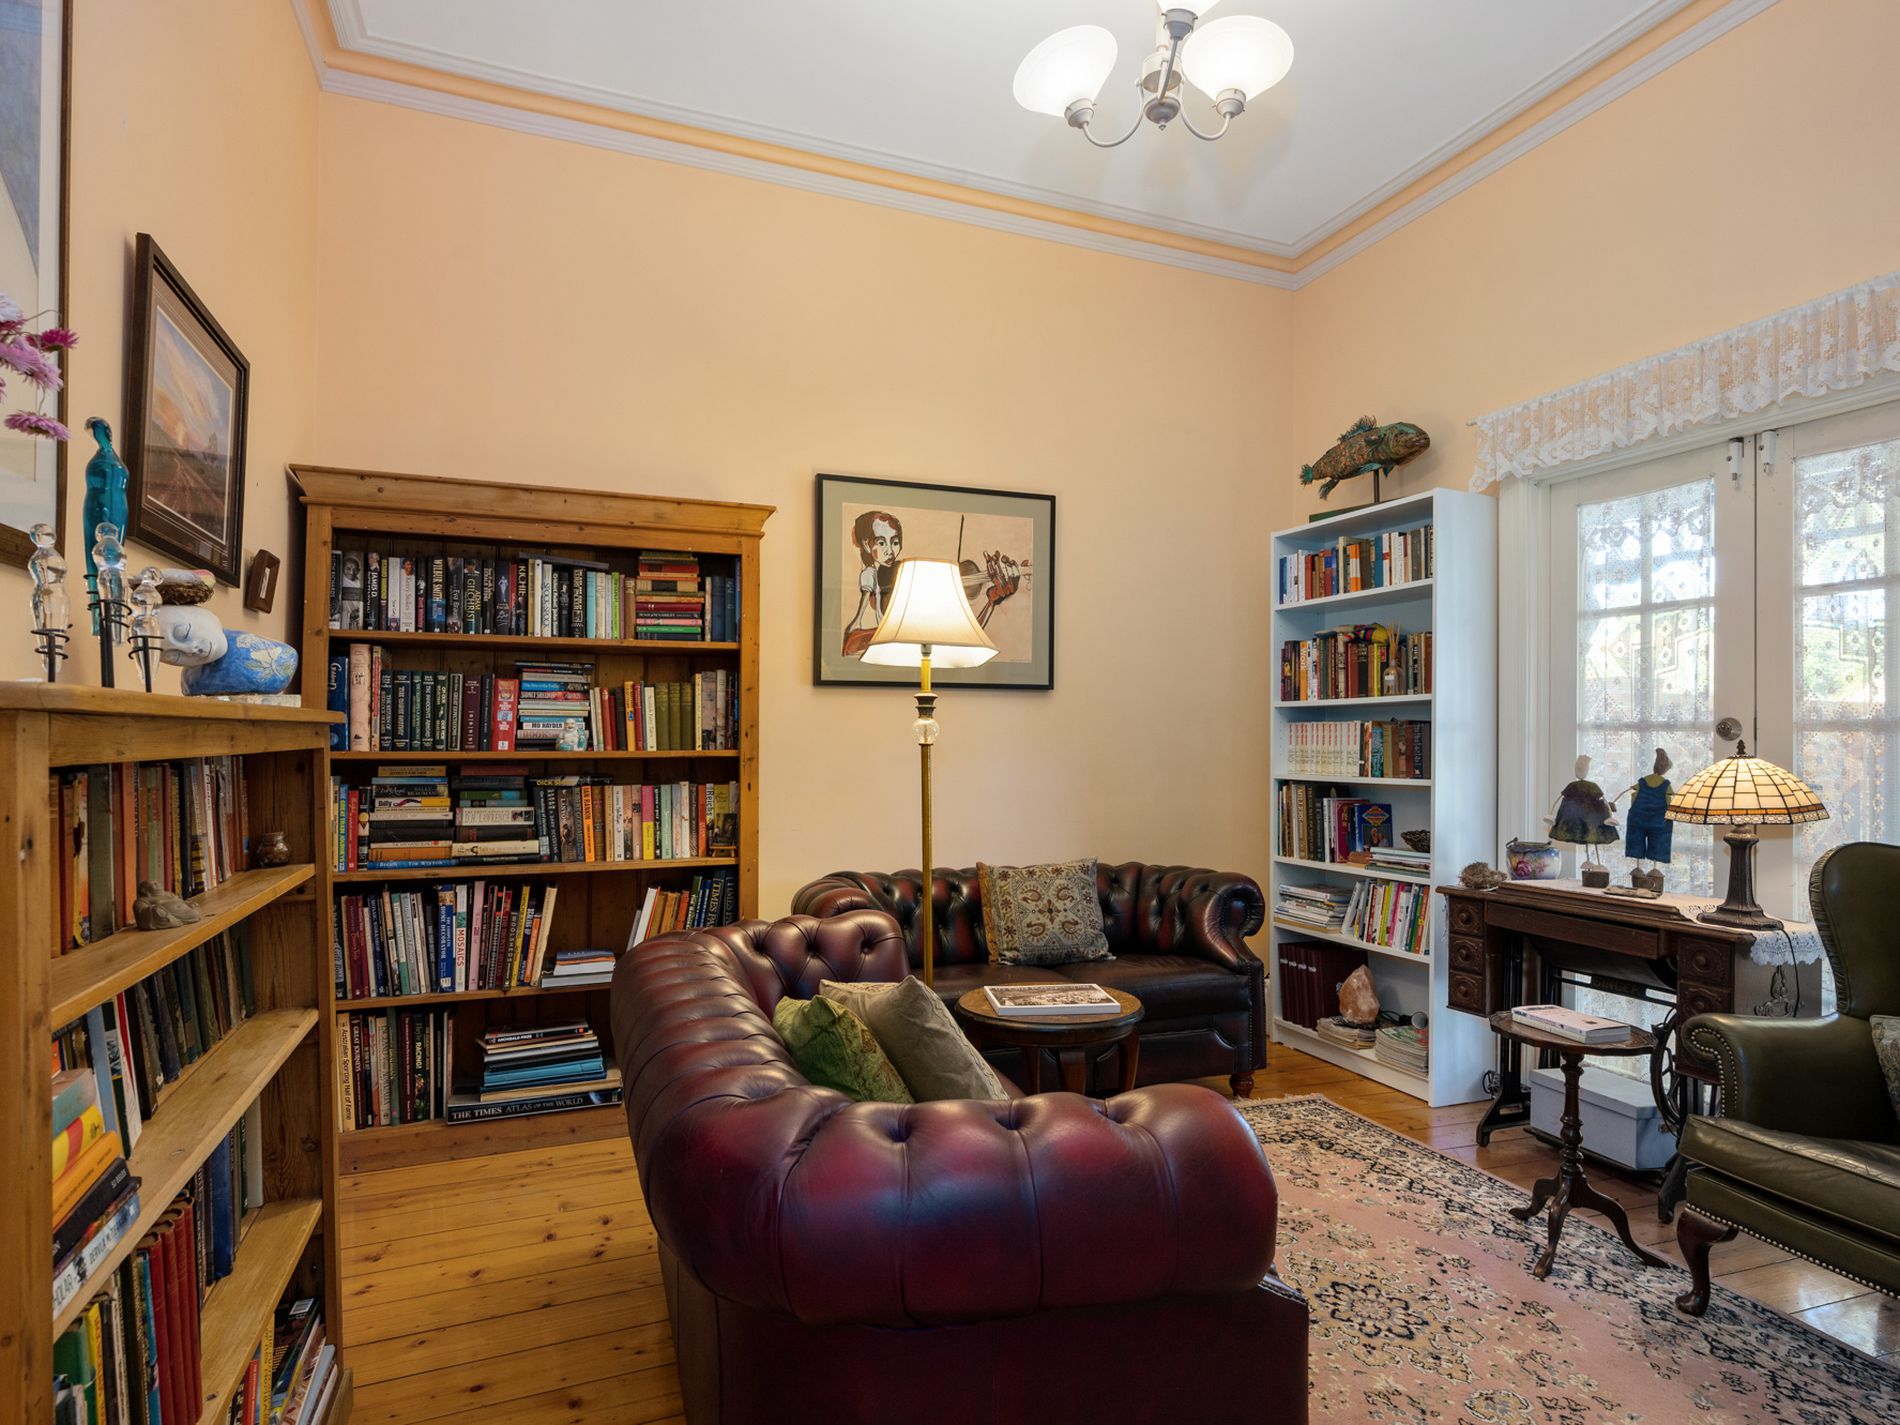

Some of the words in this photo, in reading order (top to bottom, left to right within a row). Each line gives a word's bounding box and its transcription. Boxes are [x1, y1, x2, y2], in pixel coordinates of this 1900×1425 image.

[433, 559, 443, 582] WILBUR
[518, 566, 527, 596] RICHIE
[433, 584, 442, 602] SMITH
[466, 578, 476, 622] GILCHRIST
[1300, 647, 1308, 670] Work
[706, 791, 714, 816] Reichs
[710, 882, 720, 912] TIMES
[726, 882, 735, 910] TIMES
[456, 929, 464, 967] MOSAICS
[506, 916, 517, 962] WOOLSHEDS
[342, 1059, 350, 1084] Sporting
[451, 1110, 472, 1120] THE
[473, 1106, 502, 1118] TIMES
[505, 1104, 532, 1113] ATLAS
[556, 1098, 584, 1108] WORLD
